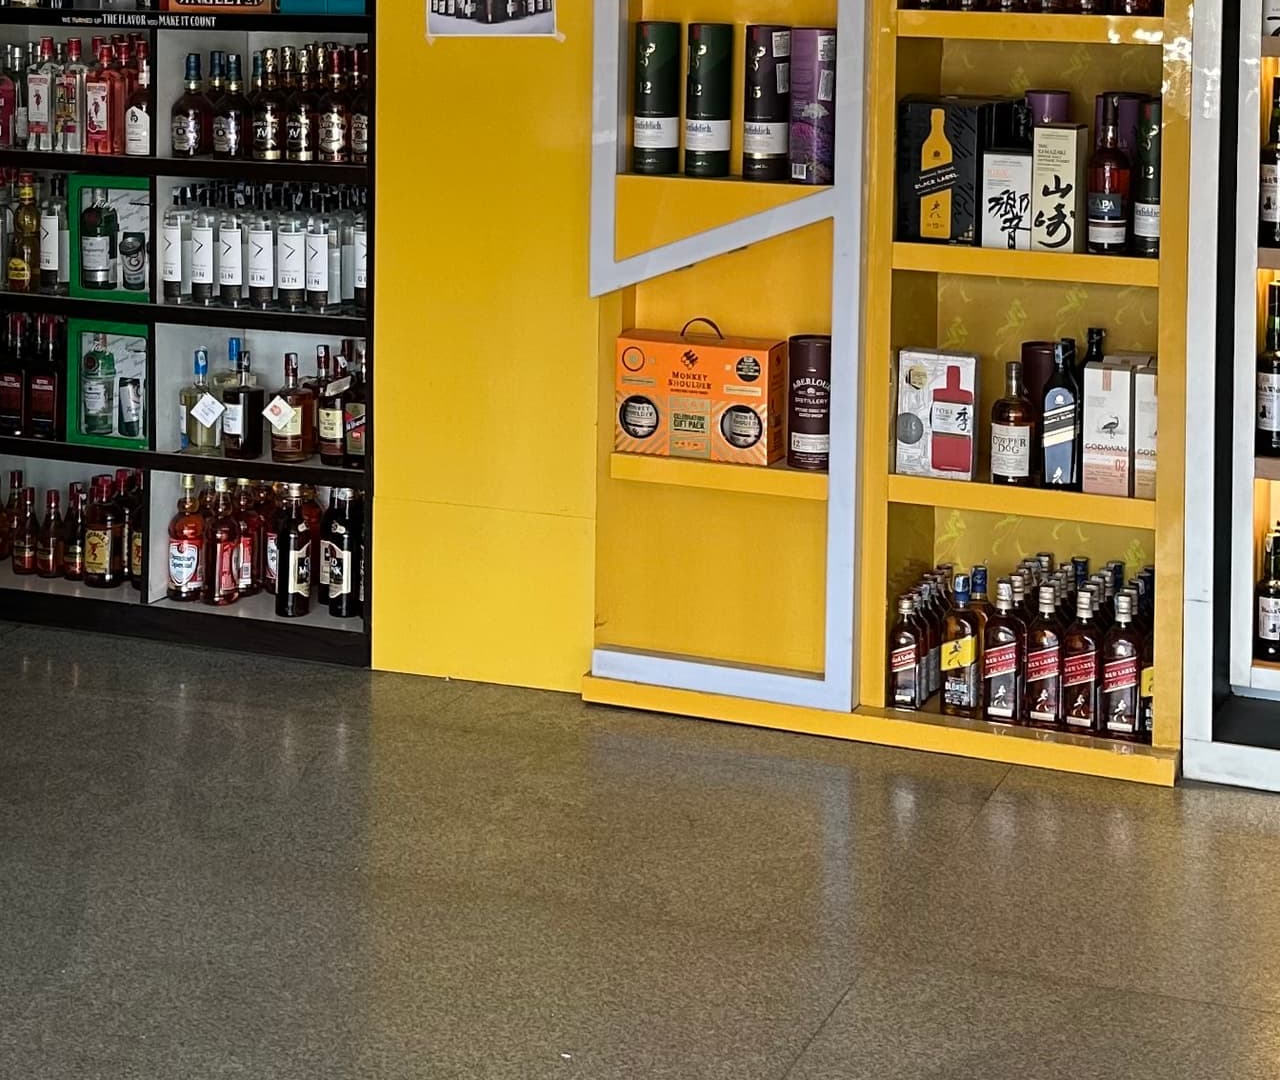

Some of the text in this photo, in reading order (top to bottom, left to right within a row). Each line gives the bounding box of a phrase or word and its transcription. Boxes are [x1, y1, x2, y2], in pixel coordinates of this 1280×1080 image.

[102, 14, 117, 25] THE
[118, 14, 146, 25] FLAVOR
[159, 15, 180, 26] MAKE
[181, 16, 188, 26] IT
[190, 16, 216, 27] COUNT
[251, 274, 267, 284] GIN
[281, 275, 298, 285] GIN
[671, 371, 708, 381] MONKEY
[668, 380, 712, 390] SHOULDER
[673, 420, 705, 430] GIFT PACK
[992, 436, 1026, 448] COPPER
[1085, 442, 1127, 452] GODAWAN
[998, 445, 1019, 455] DOG
[1115, 459, 1126, 472] 02
